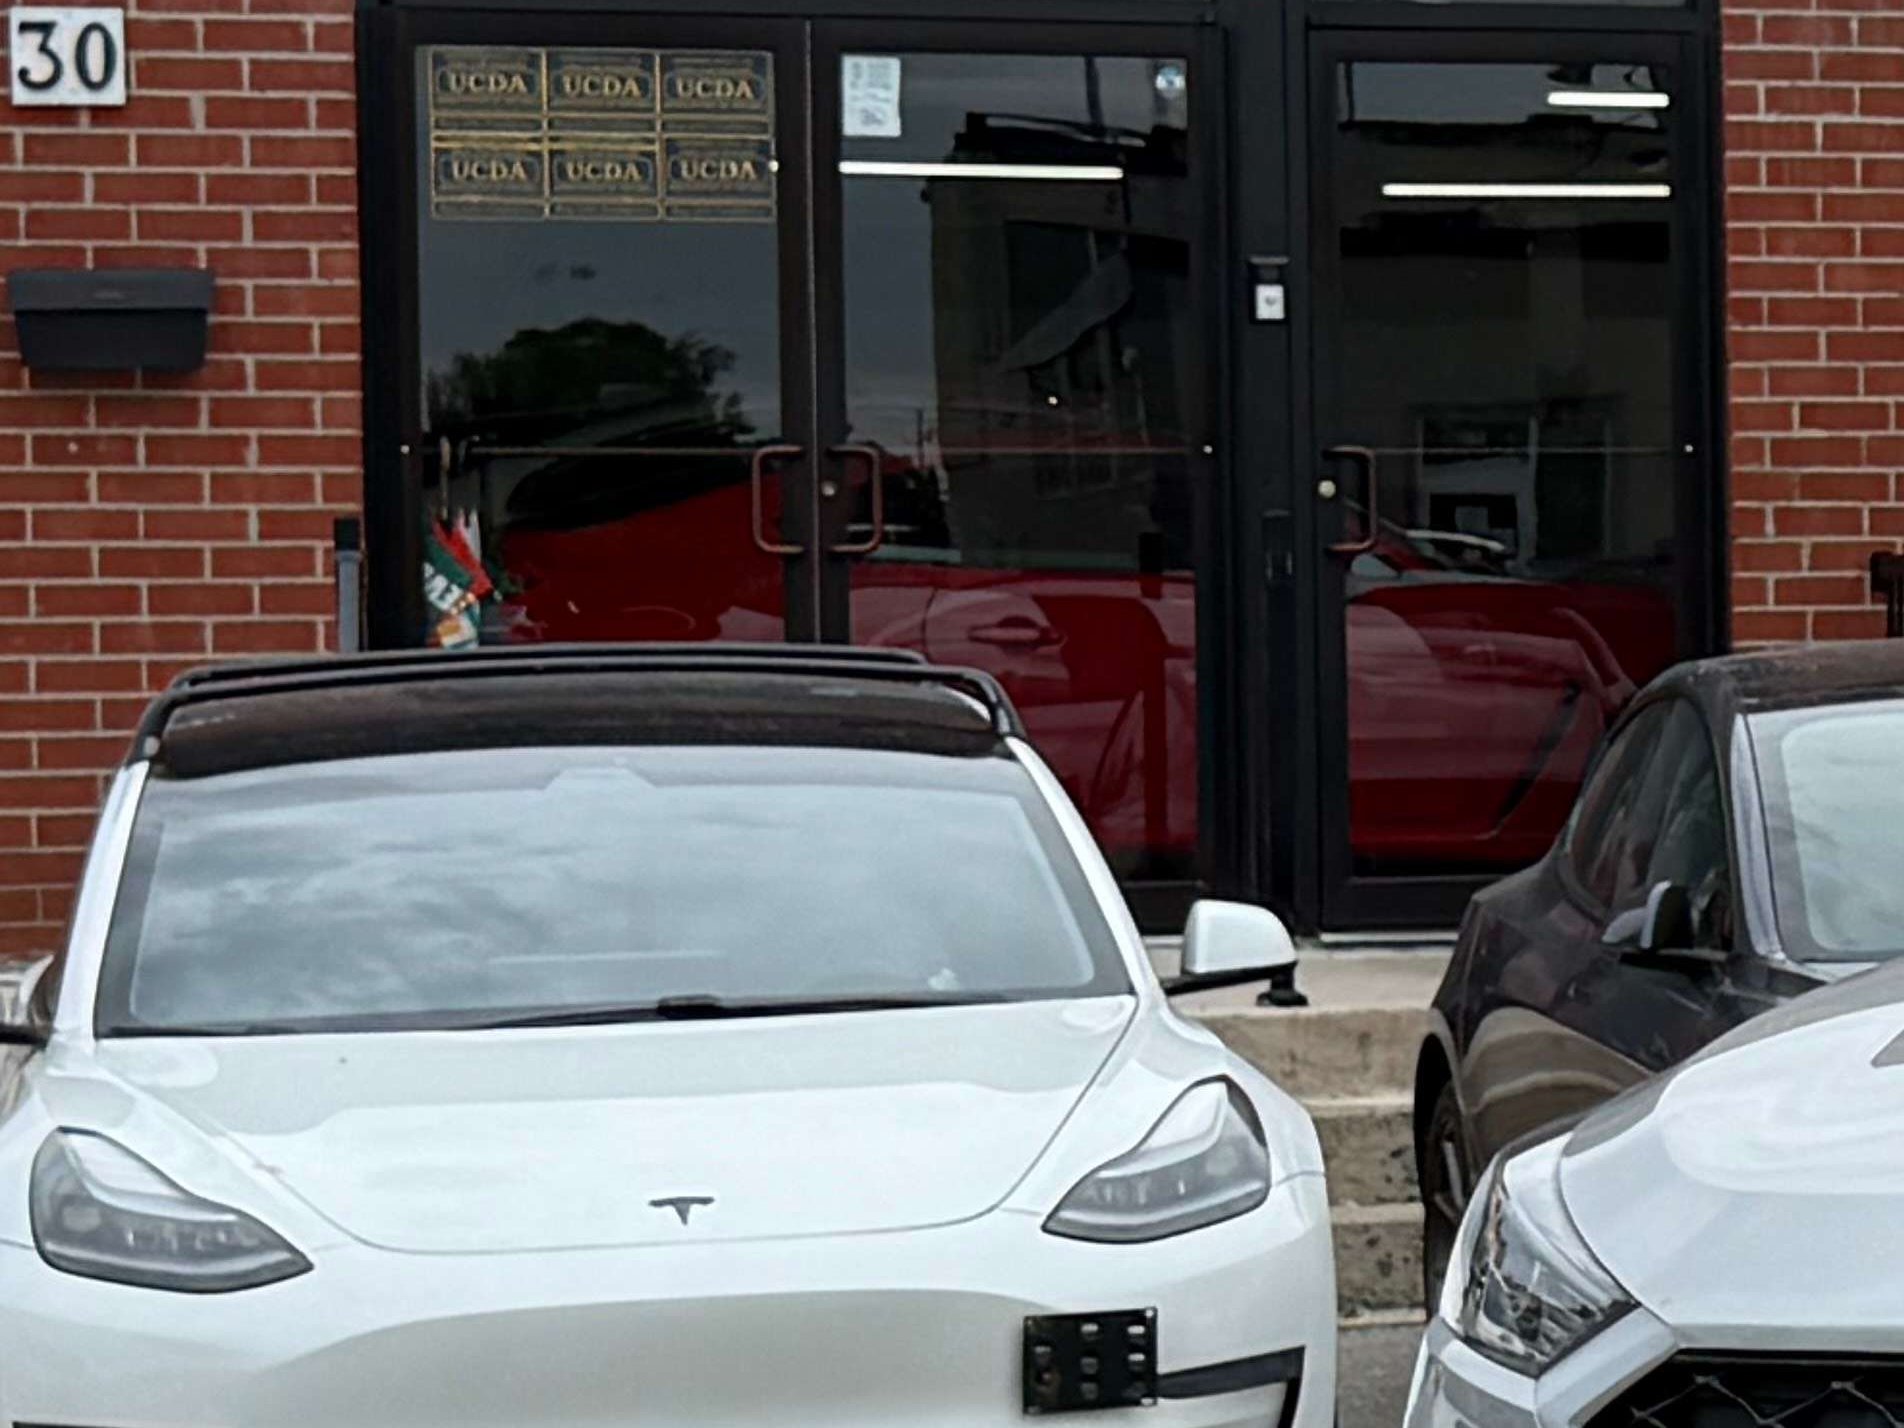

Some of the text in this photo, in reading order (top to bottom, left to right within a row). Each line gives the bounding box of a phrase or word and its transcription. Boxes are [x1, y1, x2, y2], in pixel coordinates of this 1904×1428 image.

[17, 20, 117, 91] 30
[450, 72, 528, 94] UCDA
[562, 74, 642, 96] UCDA
[675, 76, 755, 99] UCDA
[452, 159, 528, 181] UCDA
[566, 161, 642, 182] UCDA
[680, 160, 758, 181] UCDA
